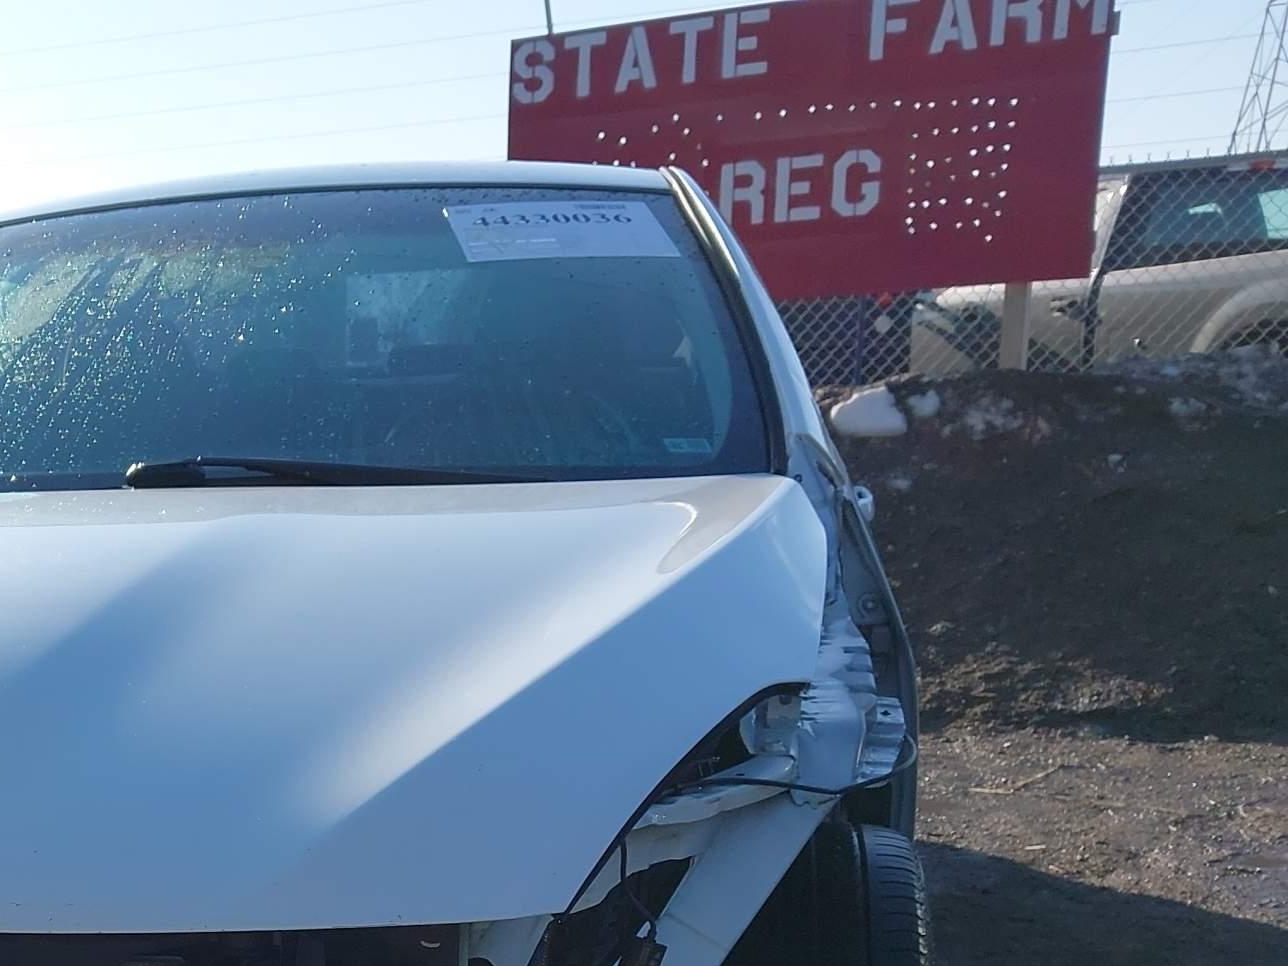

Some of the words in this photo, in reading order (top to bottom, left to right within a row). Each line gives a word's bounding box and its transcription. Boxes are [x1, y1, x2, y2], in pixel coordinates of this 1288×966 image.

[513, 8, 771, 104] STATE
[868, 0, 1109, 61] FARM
[472, 212, 632, 227] 44330036
[719, 149, 881, 225] REG
